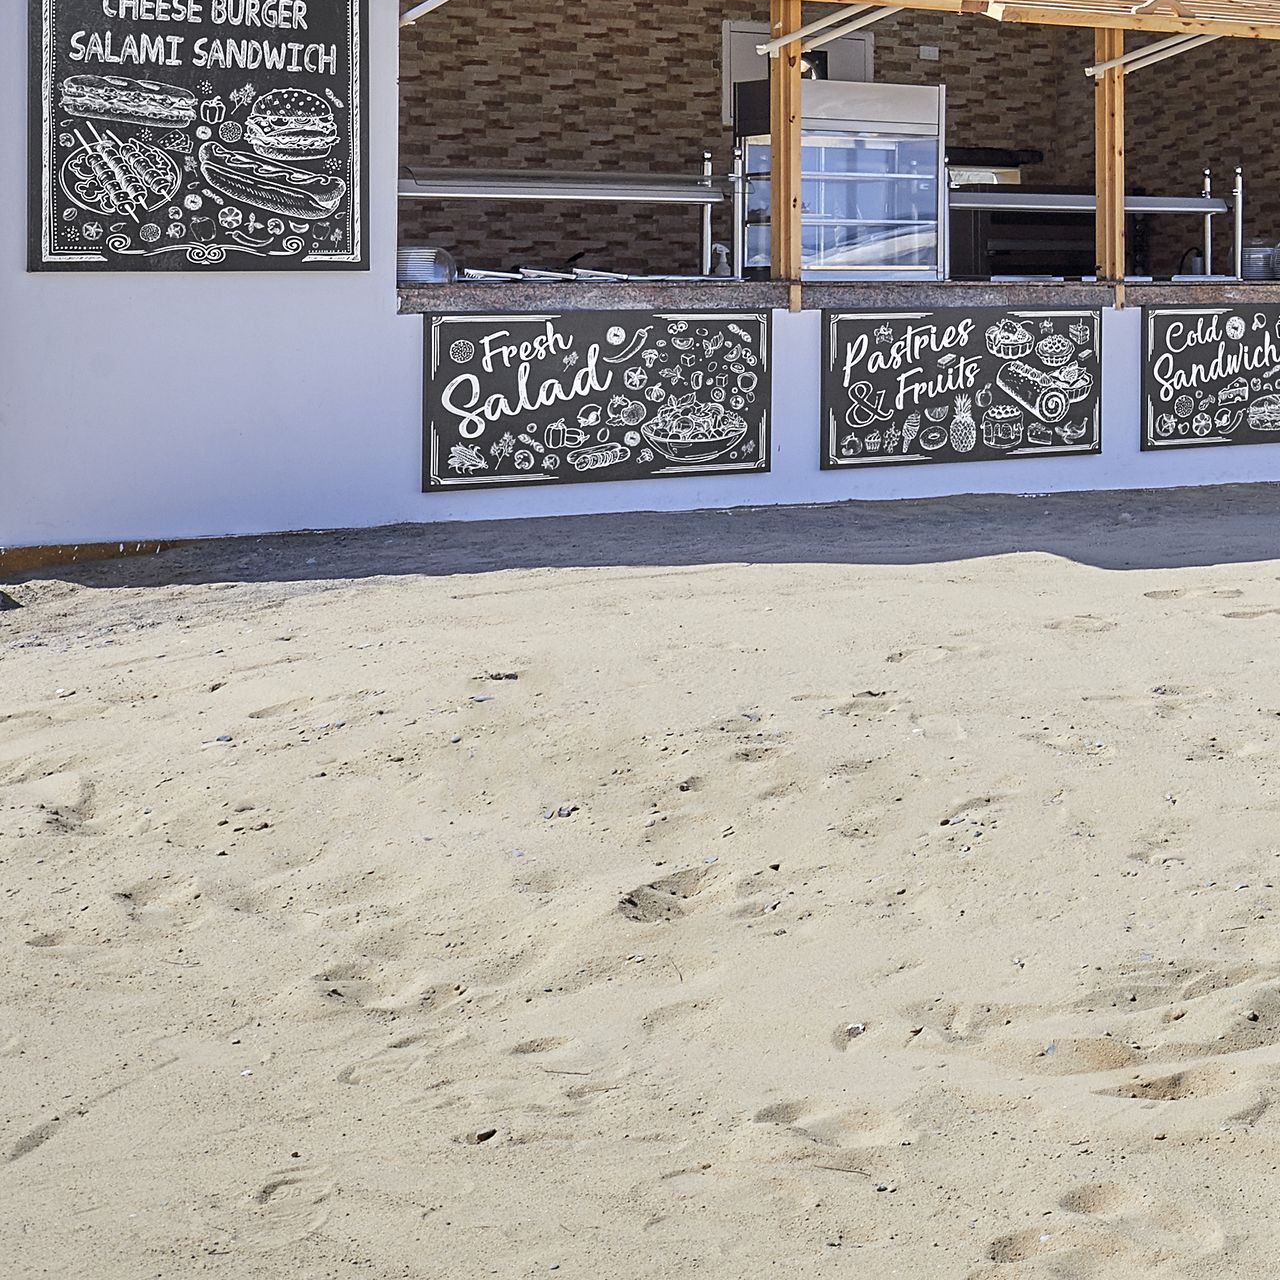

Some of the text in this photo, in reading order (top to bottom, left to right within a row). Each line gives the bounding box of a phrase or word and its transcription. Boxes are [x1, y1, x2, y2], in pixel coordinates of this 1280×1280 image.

[69, 31, 337, 75] SALAMI SANDWICH
[479, 320, 573, 372] Fresh
[843, 318, 976, 387] Pastries
[1166, 314, 1222, 352] Cold
[441, 343, 613, 438] Salad
[845, 355, 983, 428] & Fruits
